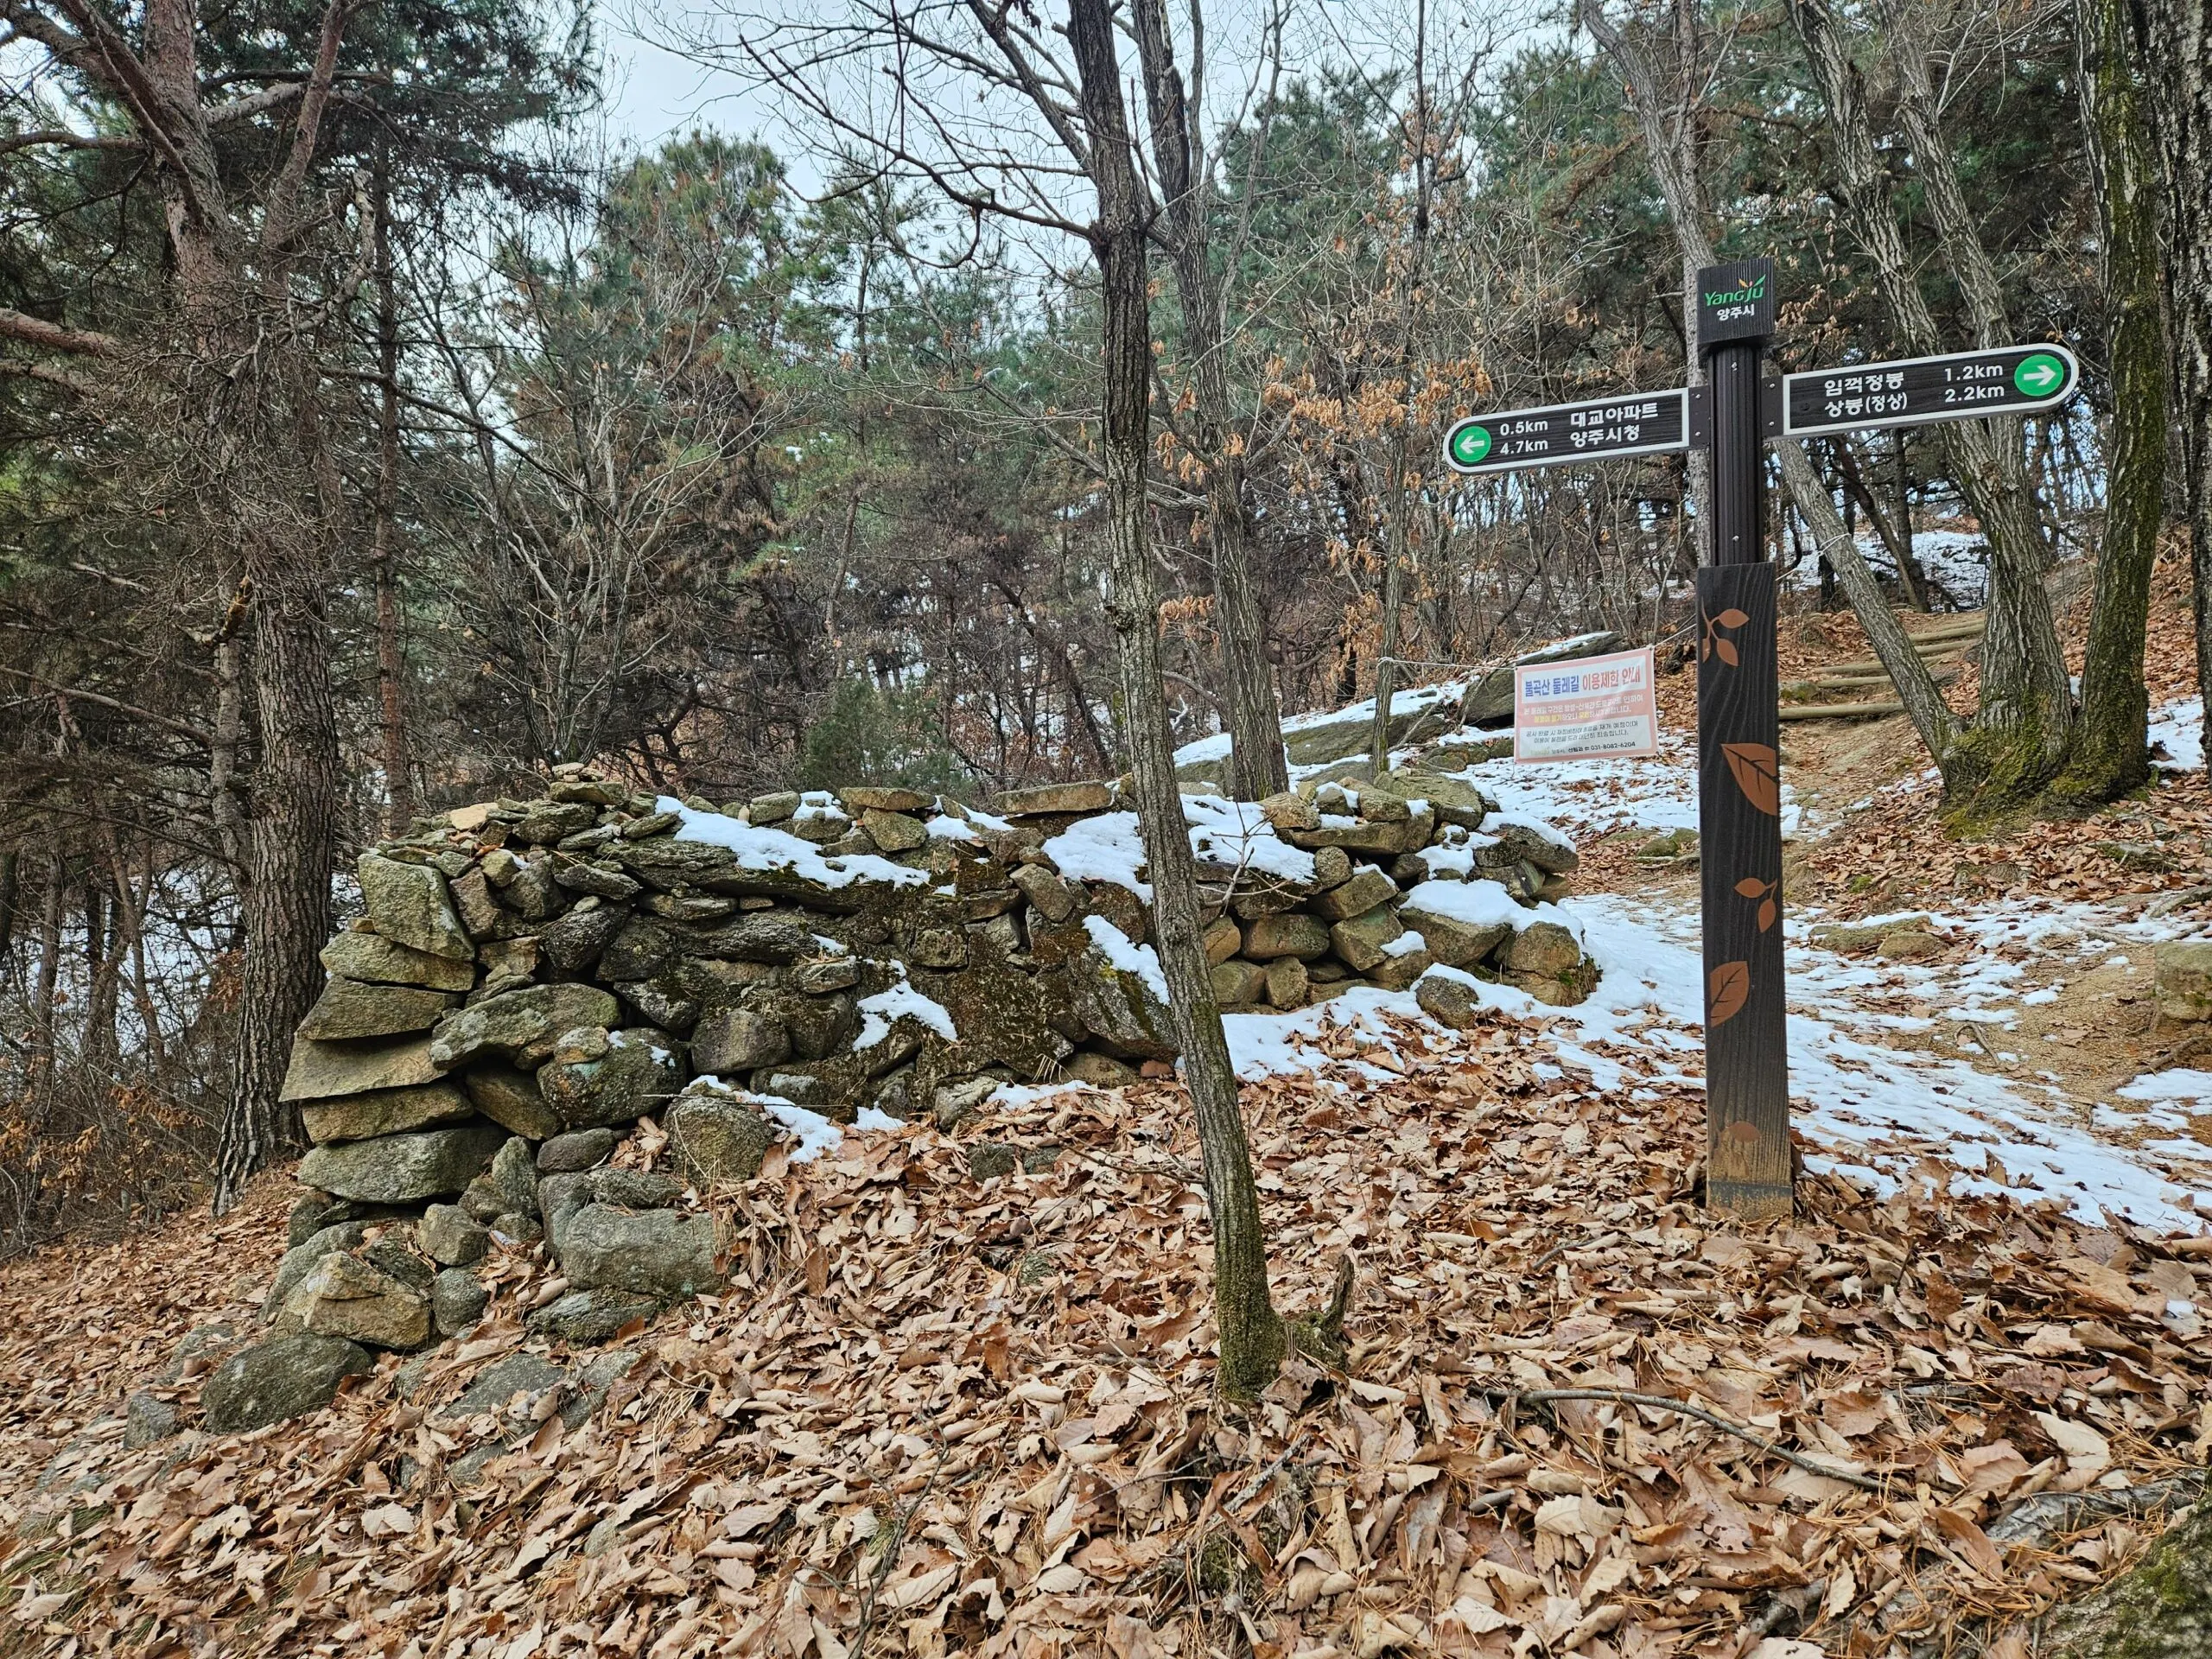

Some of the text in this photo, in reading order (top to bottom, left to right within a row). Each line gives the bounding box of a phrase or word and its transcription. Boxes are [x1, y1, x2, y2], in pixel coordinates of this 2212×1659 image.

[1704, 284, 1765, 307] Yangju
[1716, 303, 1755, 321] 양주시
[1824, 363, 2004, 397] 임꺽정봉 1.2km
[1824, 385, 2005, 417] 상봉(정상) 2.2km
[1500, 402, 1658, 436] 0.5km 대교아파트
[1500, 424, 1640, 455] 4.7km 양주시청
[1525, 665, 1641, 697] 불곡산 둘레길 이용제한 안내
[1591, 741, 1636, 751] 031-8082-6204
